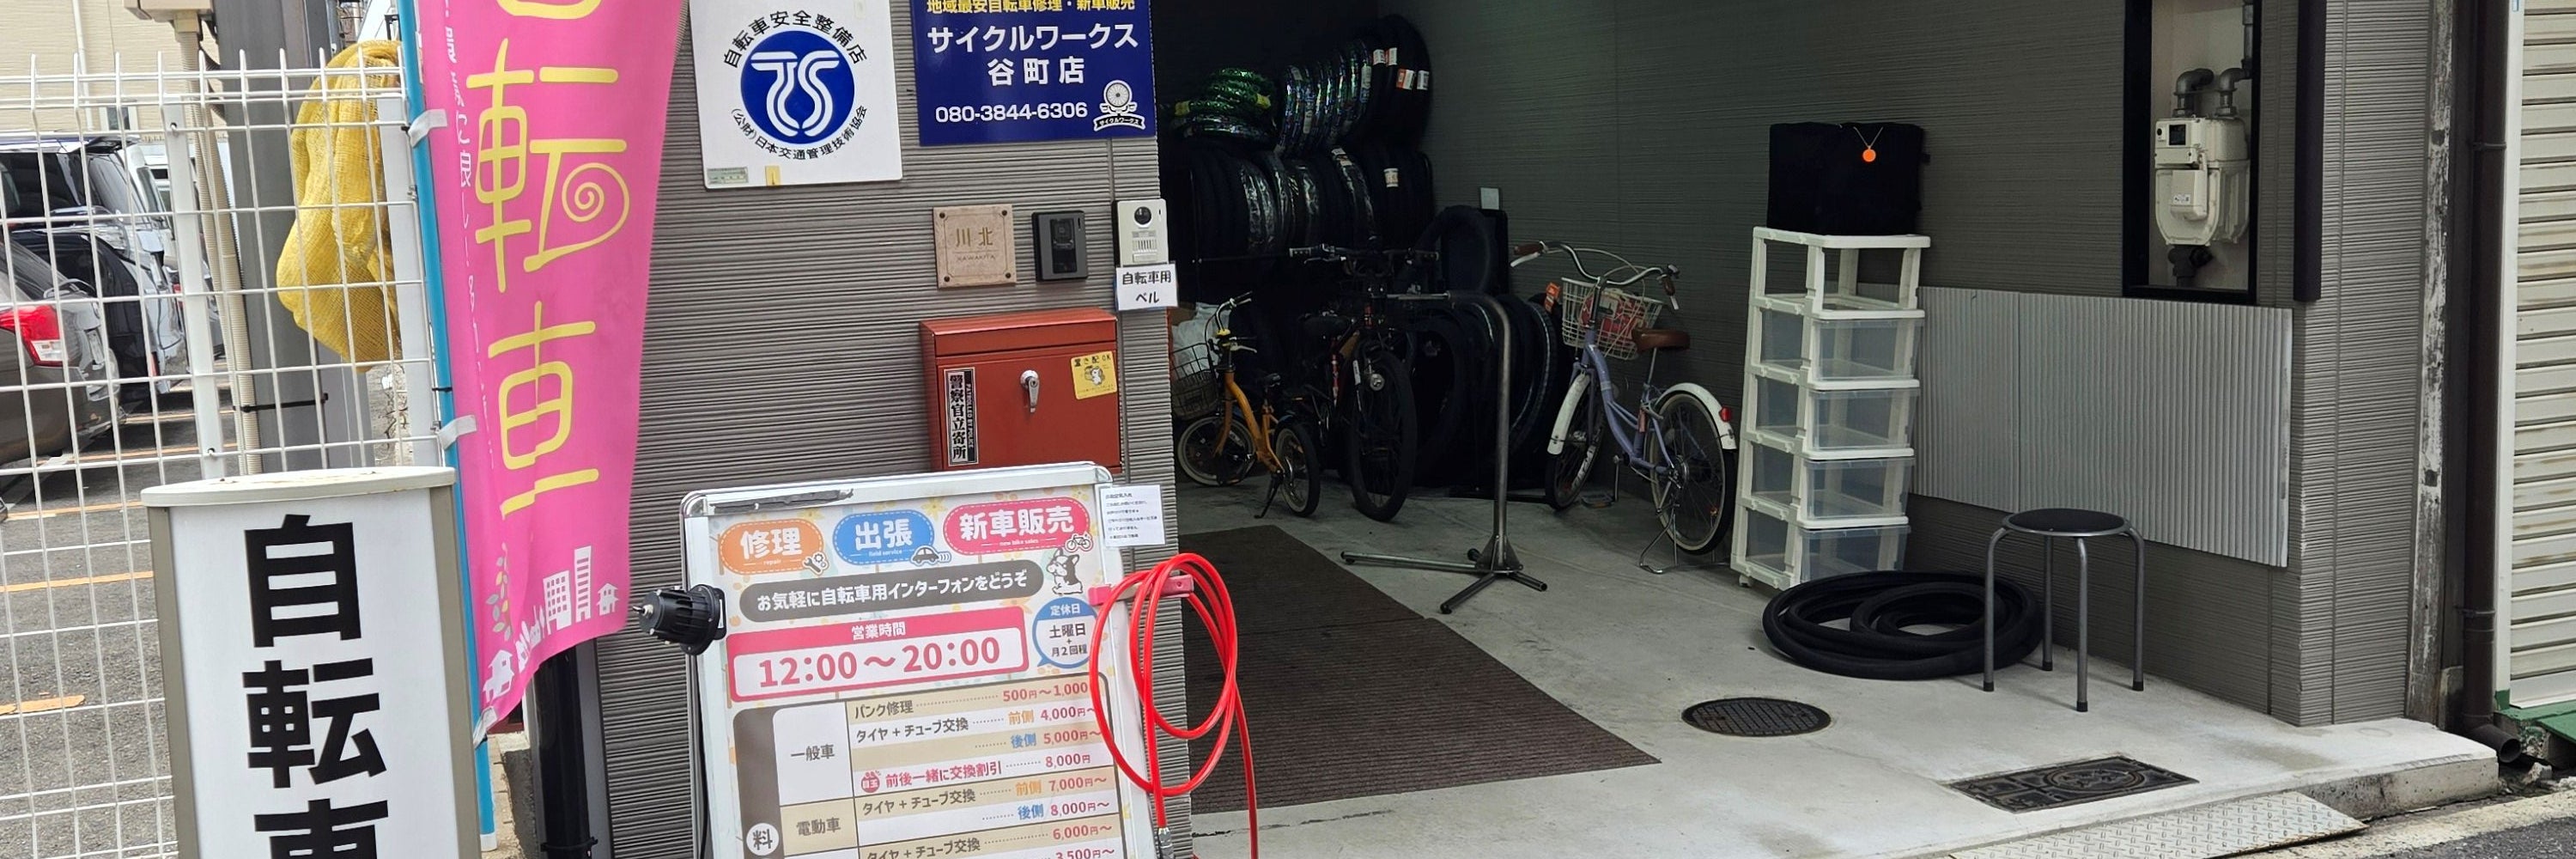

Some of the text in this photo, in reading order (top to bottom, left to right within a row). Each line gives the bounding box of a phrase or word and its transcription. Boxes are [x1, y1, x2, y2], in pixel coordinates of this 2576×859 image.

[724, 10, 867, 68] 自転車安全整備店
[927, 23, 1139, 53] サイクルワークス
[987, 56, 1084, 86] 谷町店
[935, 102, 1088, 123] 080-3844-6306
[956, 227, 993, 247] 川北
[466, 0, 630, 521] 転車
[1121, 271, 1172, 285] 自転車用
[1135, 291, 1160, 304] ベル
[950, 375, 967, 460] 警察官立寄所
[959, 505, 1075, 541] 新車販売
[739, 527, 803, 559] 修理
[854, 519, 914, 551] 出張
[757, 569, 1027, 612] お気軽に自転車用インターフォンをどうぞ
[1050, 604, 1080, 616] 定休日
[852, 621, 906, 640] 営業時間
[1049, 623, 1086, 639] 土曜日
[1051, 644, 1087, 657] 月2回程
[855, 682, 1089, 719] パンク修理 500円～1,000
[1007, 710, 1035, 725] 前側
[1011, 733, 1037, 749] 後側
[790, 744, 835, 761] 一般車
[885, 753, 1091, 789] 前後一緒に交換割引 8,000円
[1015, 779, 1042, 796] 前側
[1018, 803, 1044, 820] 後側
[796, 817, 841, 837] 電動車
[752, 828, 773, 850] 料
